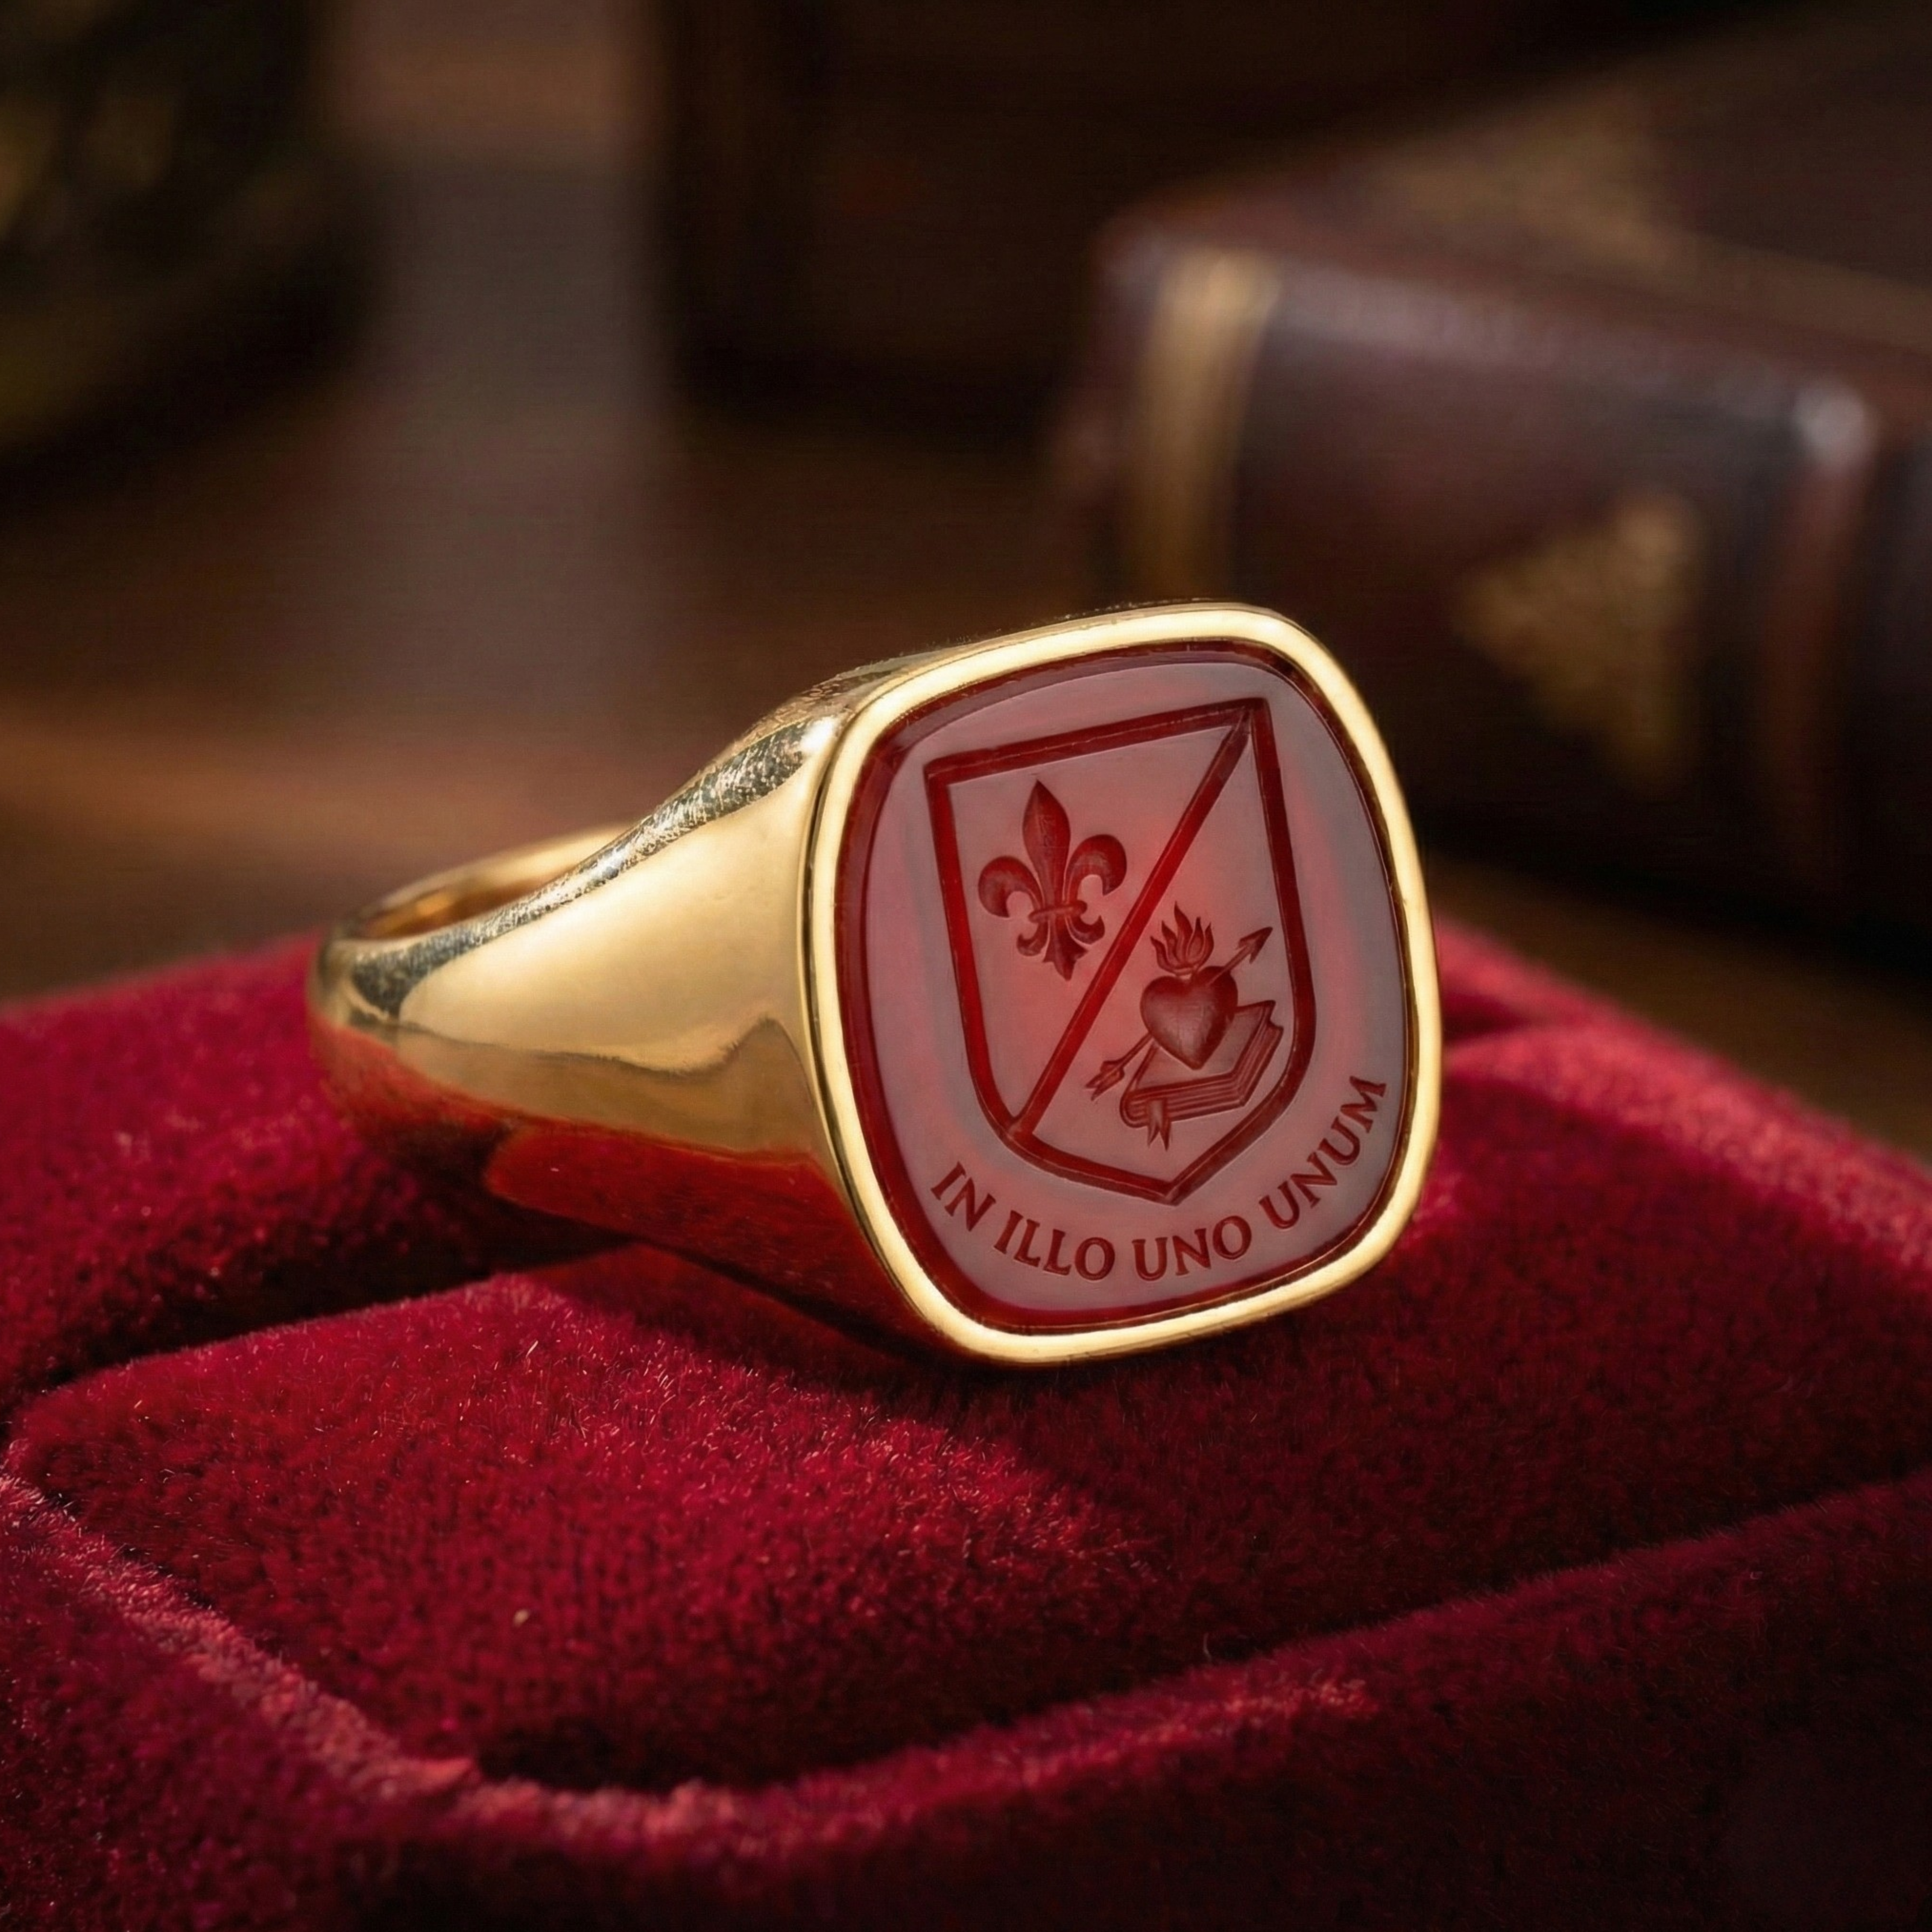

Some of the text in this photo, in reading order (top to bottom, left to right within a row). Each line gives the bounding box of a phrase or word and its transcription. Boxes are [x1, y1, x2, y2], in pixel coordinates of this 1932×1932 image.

[930, 1076, 1387, 1281] IN ILLO UNO UNUM
